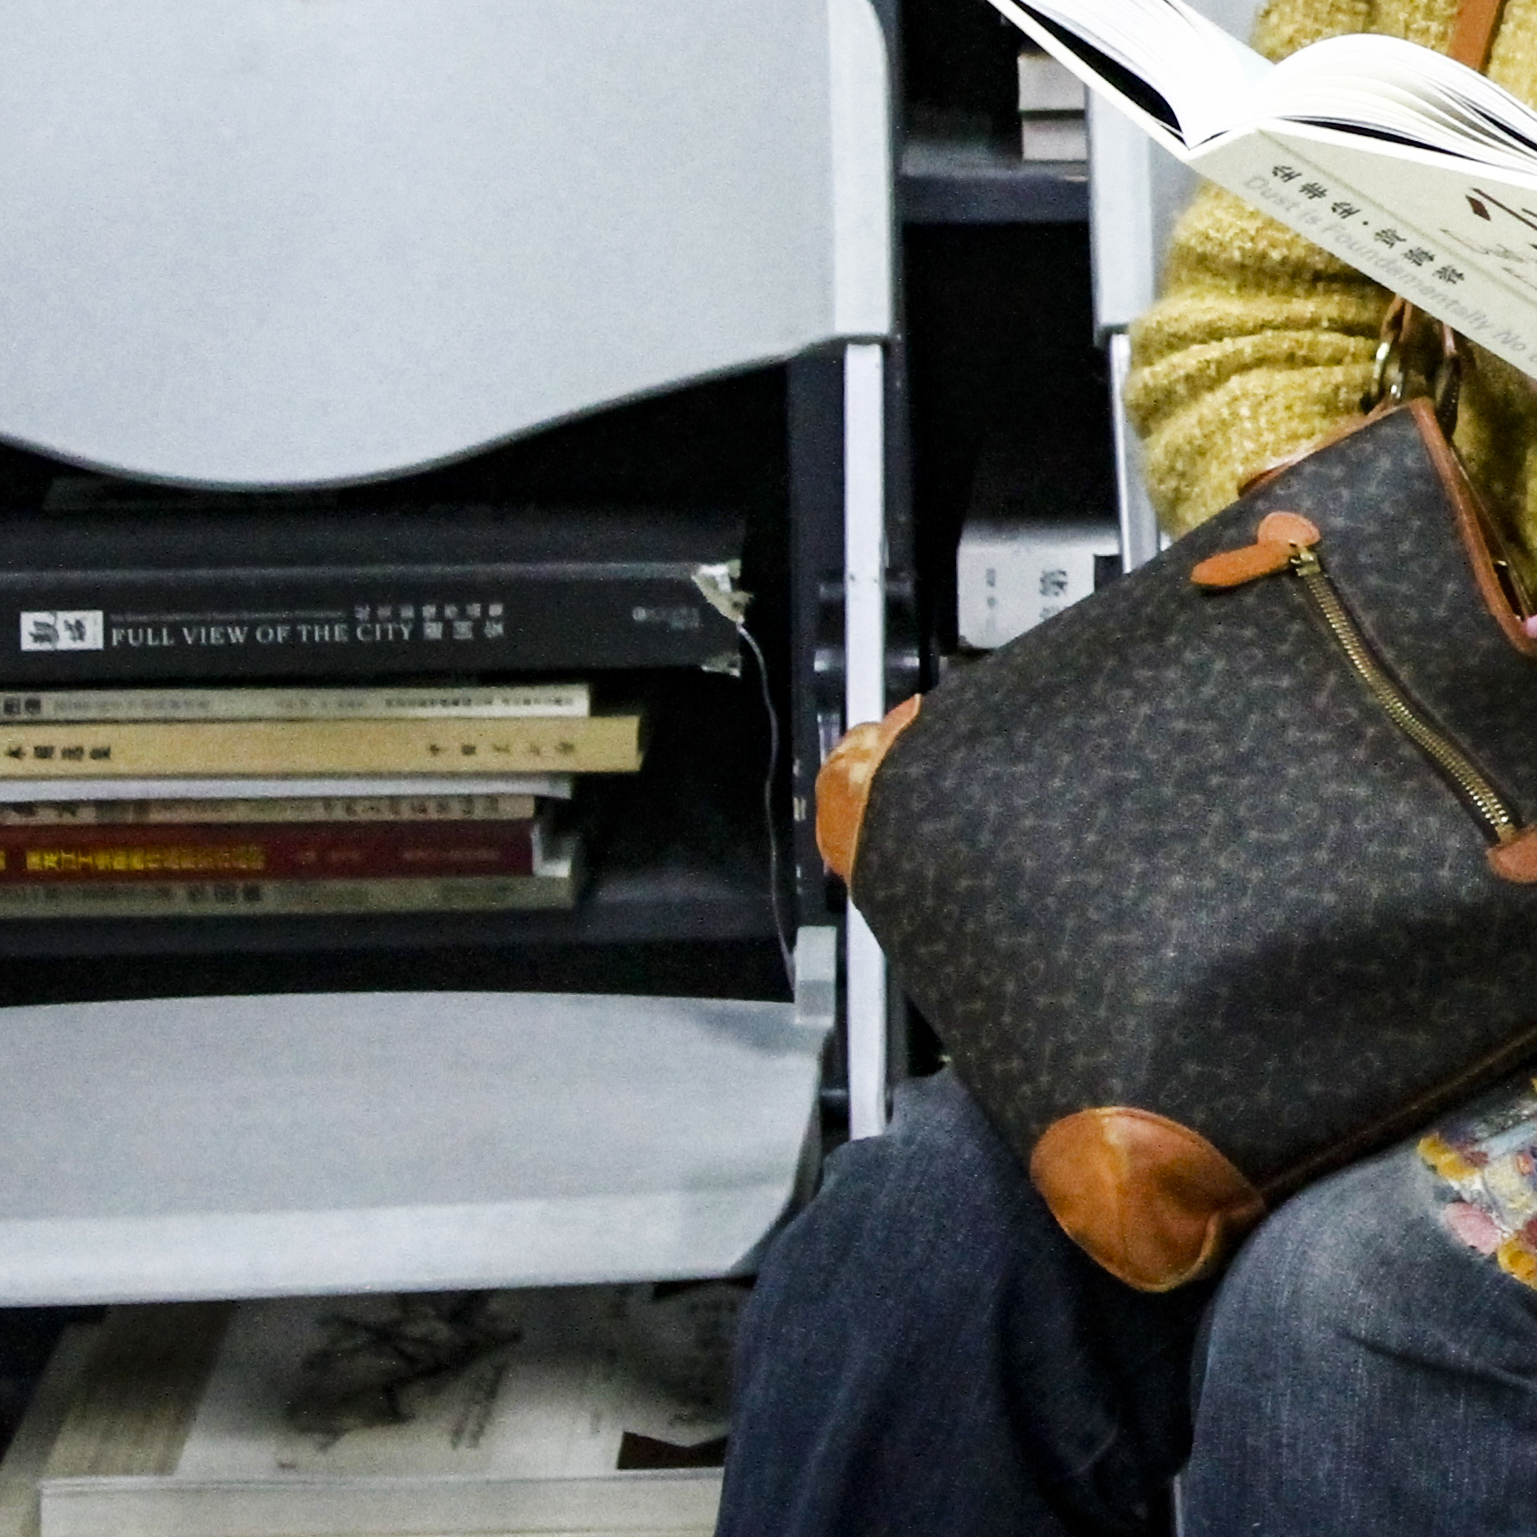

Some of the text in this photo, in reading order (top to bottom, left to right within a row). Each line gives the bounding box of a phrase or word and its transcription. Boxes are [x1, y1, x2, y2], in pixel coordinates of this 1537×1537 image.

[1243, 174, 1301, 211] Dust
[1492, 326, 1527, 353] No
[111, 623, 415, 647] FULL VIEW OF THE CITY
